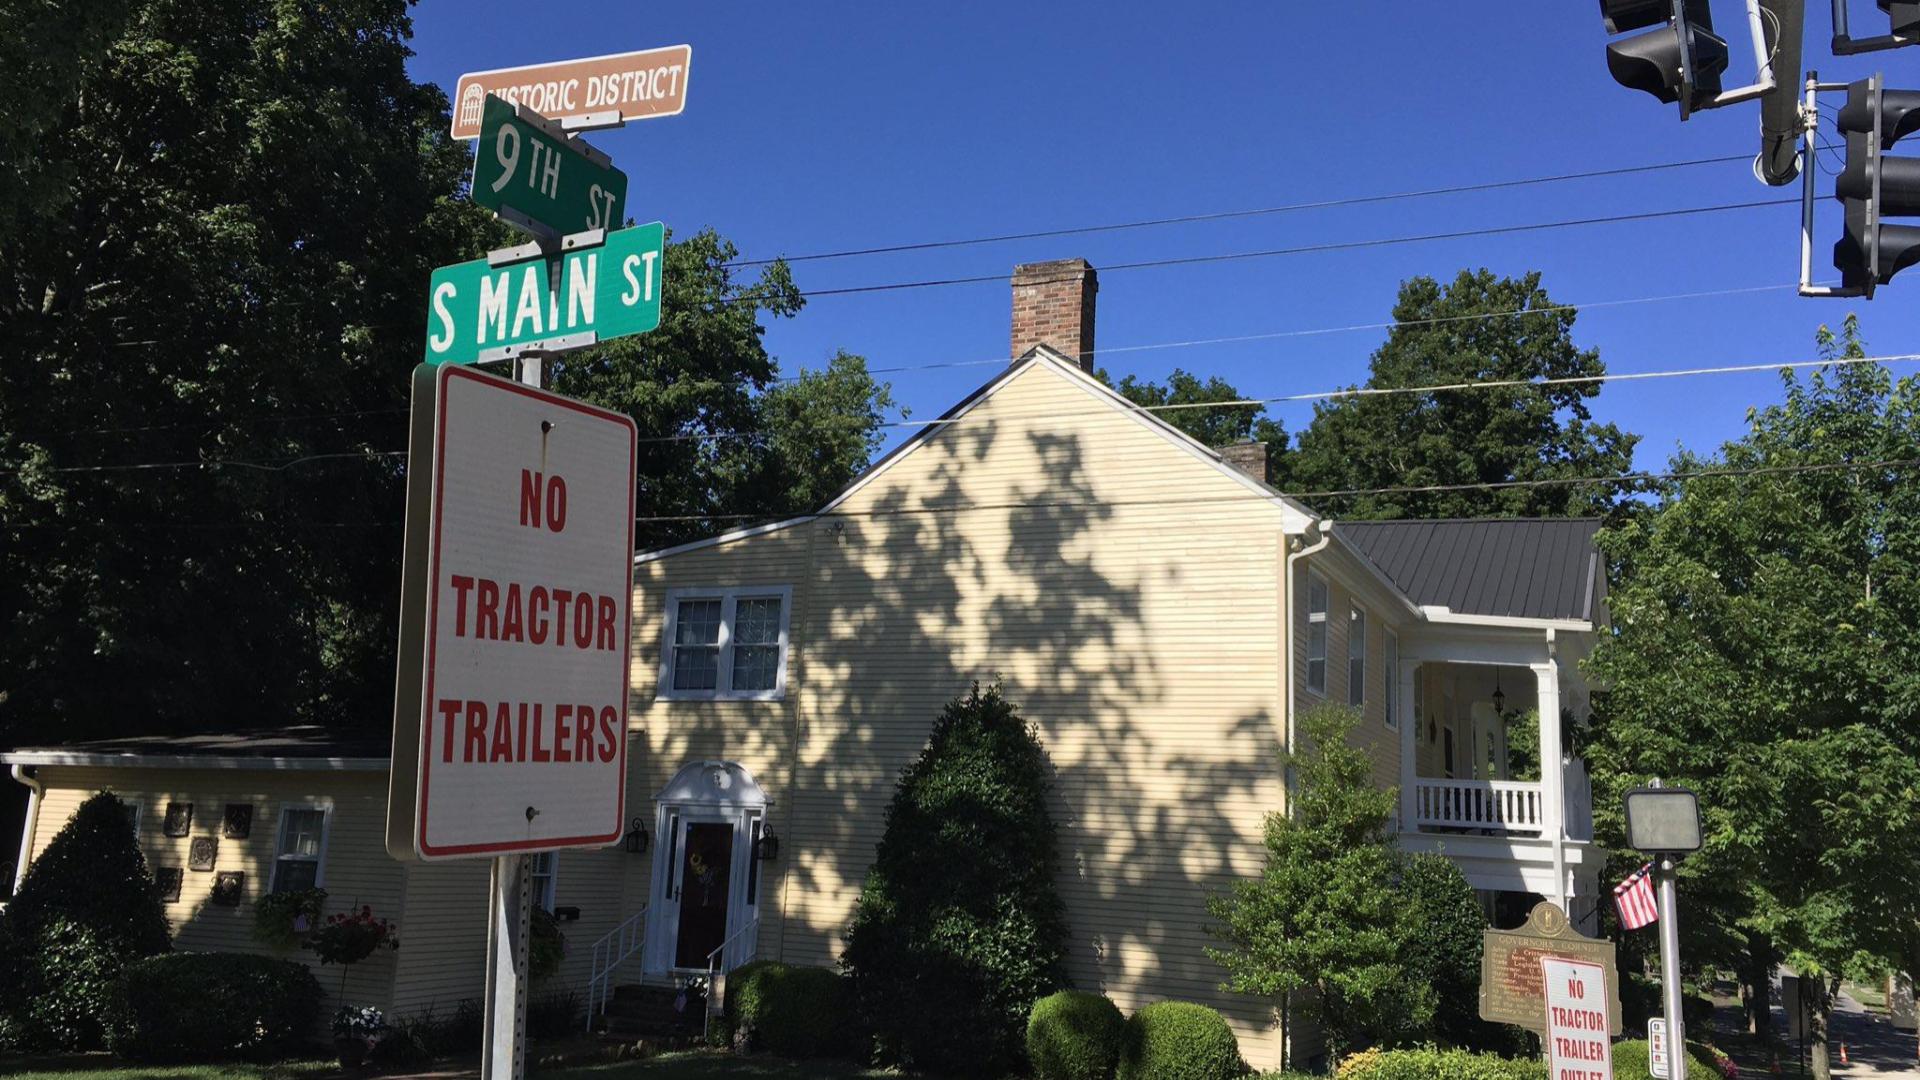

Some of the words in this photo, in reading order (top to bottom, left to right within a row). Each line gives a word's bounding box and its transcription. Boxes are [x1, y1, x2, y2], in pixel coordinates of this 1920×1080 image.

[488, 79, 579, 113] STORIC
[585, 65, 682, 108] DISTRICT
[491, 122, 561, 199] 9TH
[586, 183, 616, 231] ST
[430, 281, 457, 353] S
[477, 253, 597, 344] MAIN
[621, 250, 658, 306] ST
[519, 468, 567, 533] NO
[451, 574, 617, 651] TRACTOR
[439, 699, 617, 763] TRAILERS
[1552, 1007, 1604, 1031] TRACTOR
[1568, 979, 1584, 999] NO
[1556, 1038, 1604, 1061] TRAILER
